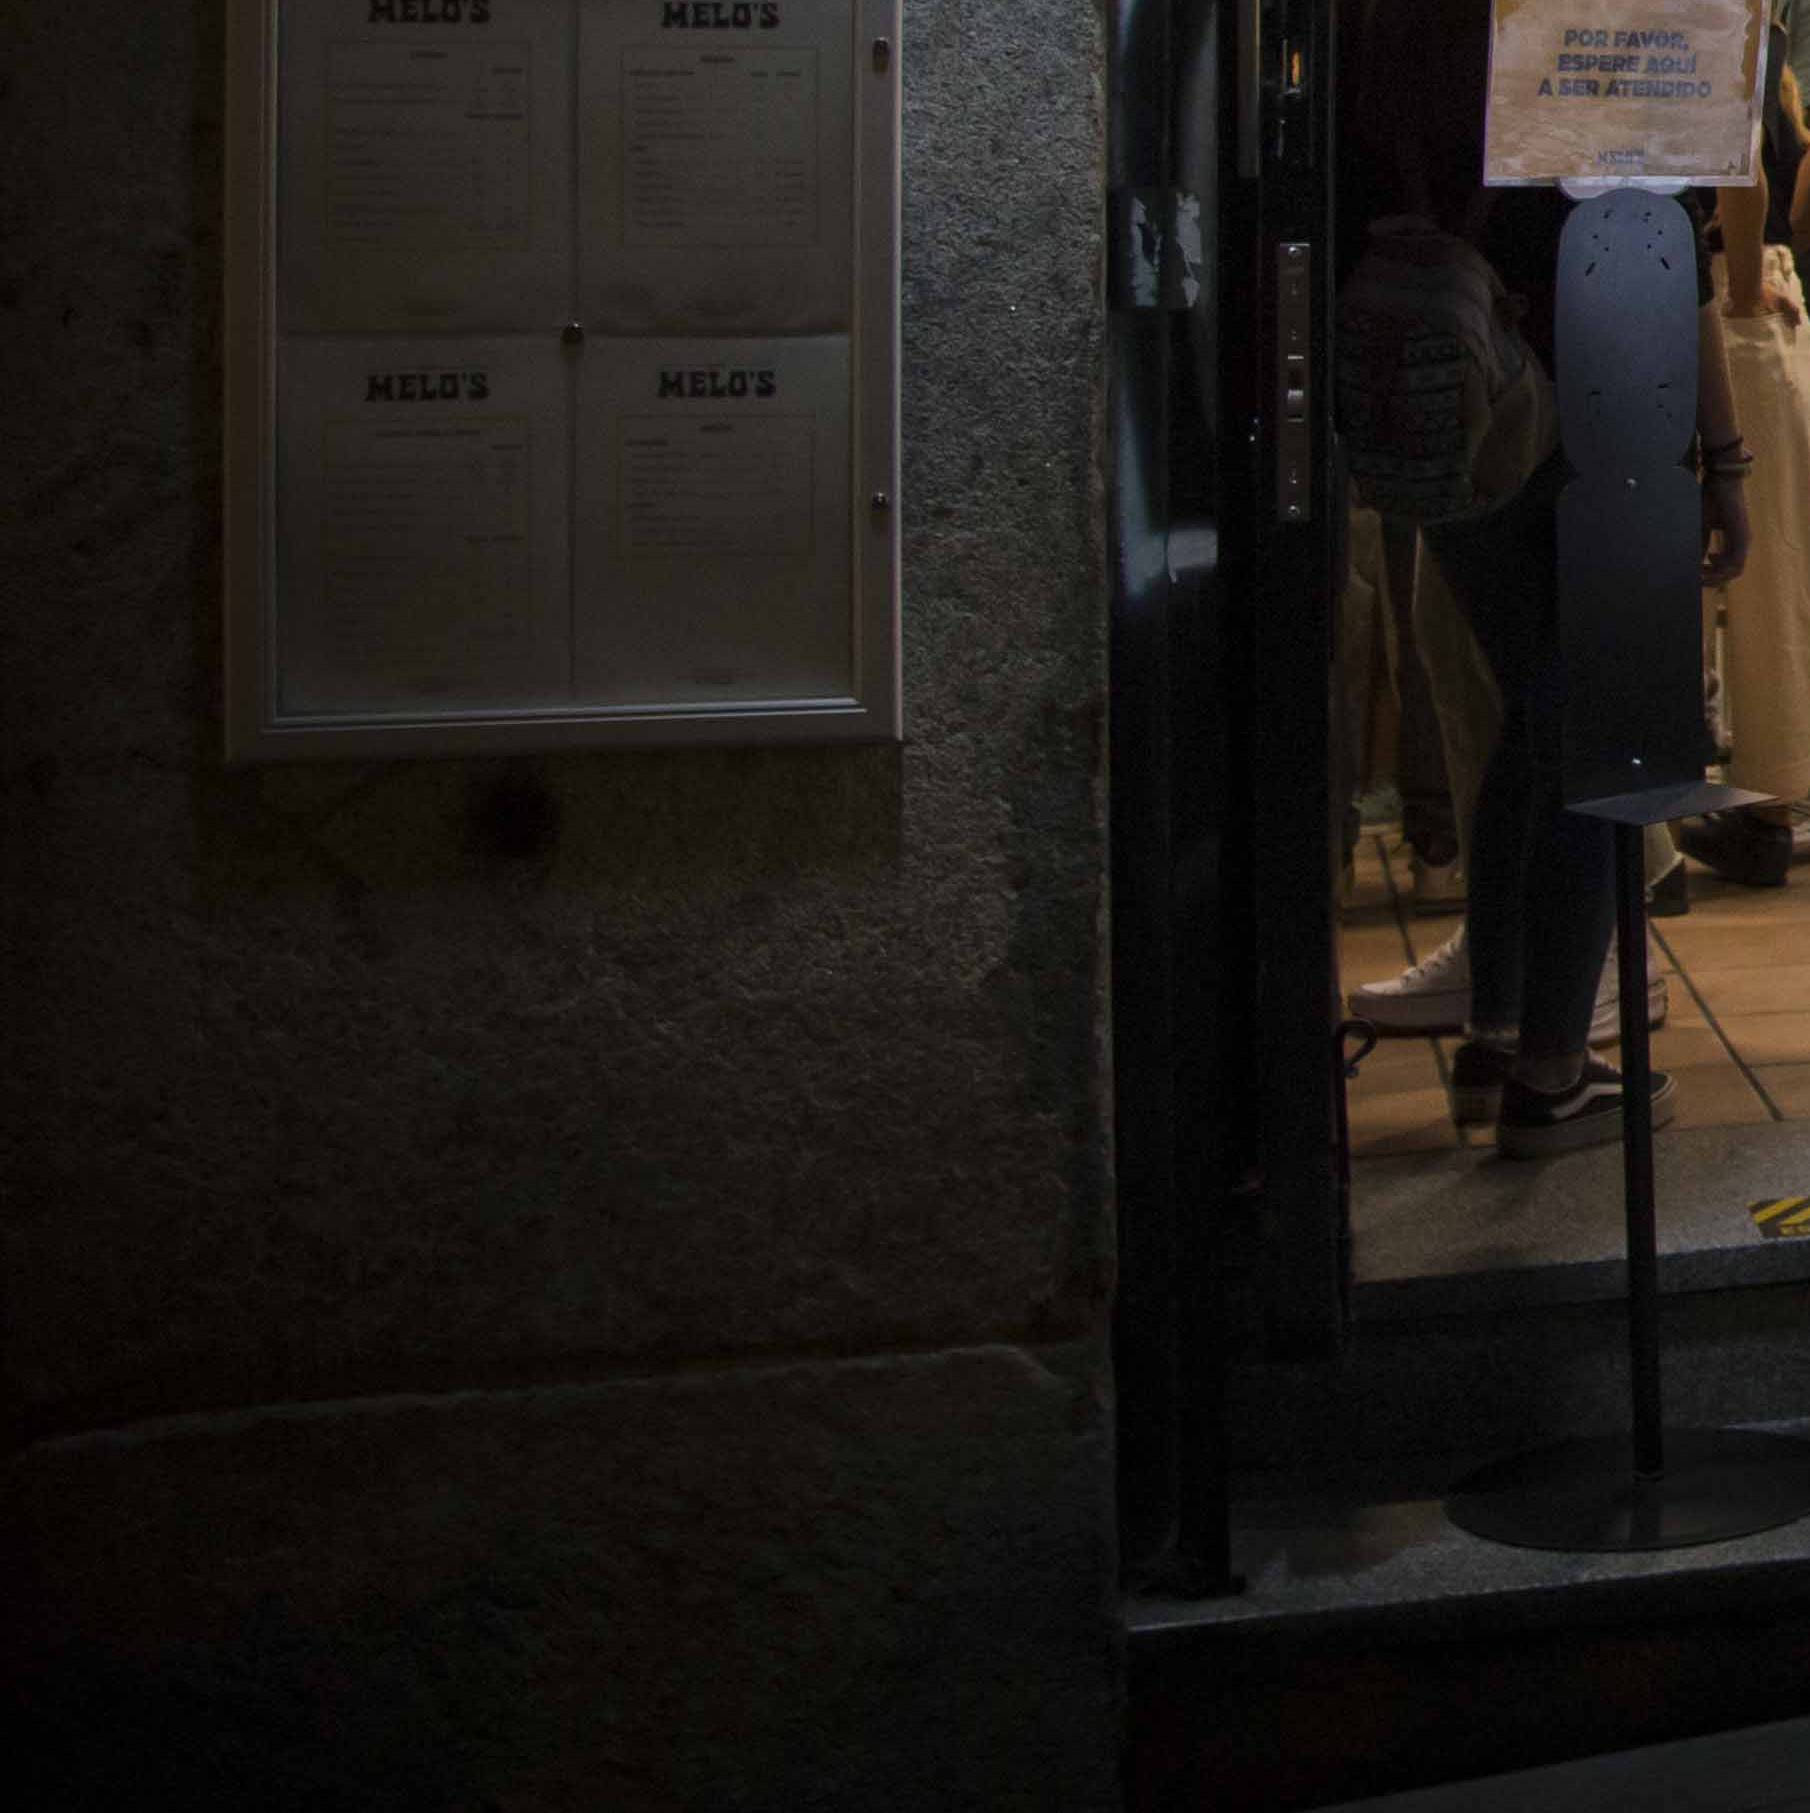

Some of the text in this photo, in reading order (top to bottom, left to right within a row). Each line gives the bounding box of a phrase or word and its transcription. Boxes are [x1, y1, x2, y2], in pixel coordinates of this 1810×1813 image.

[661, 2, 781, 30] MELO'S
[1564, 29, 1607, 47] POR
[1557, 53, 1640, 73] ESPERE
[1537, 78, 1712, 99] A SER ATENDIDO
[365, 373, 490, 402] MELO'S
[657, 369, 777, 399] MELO'S
